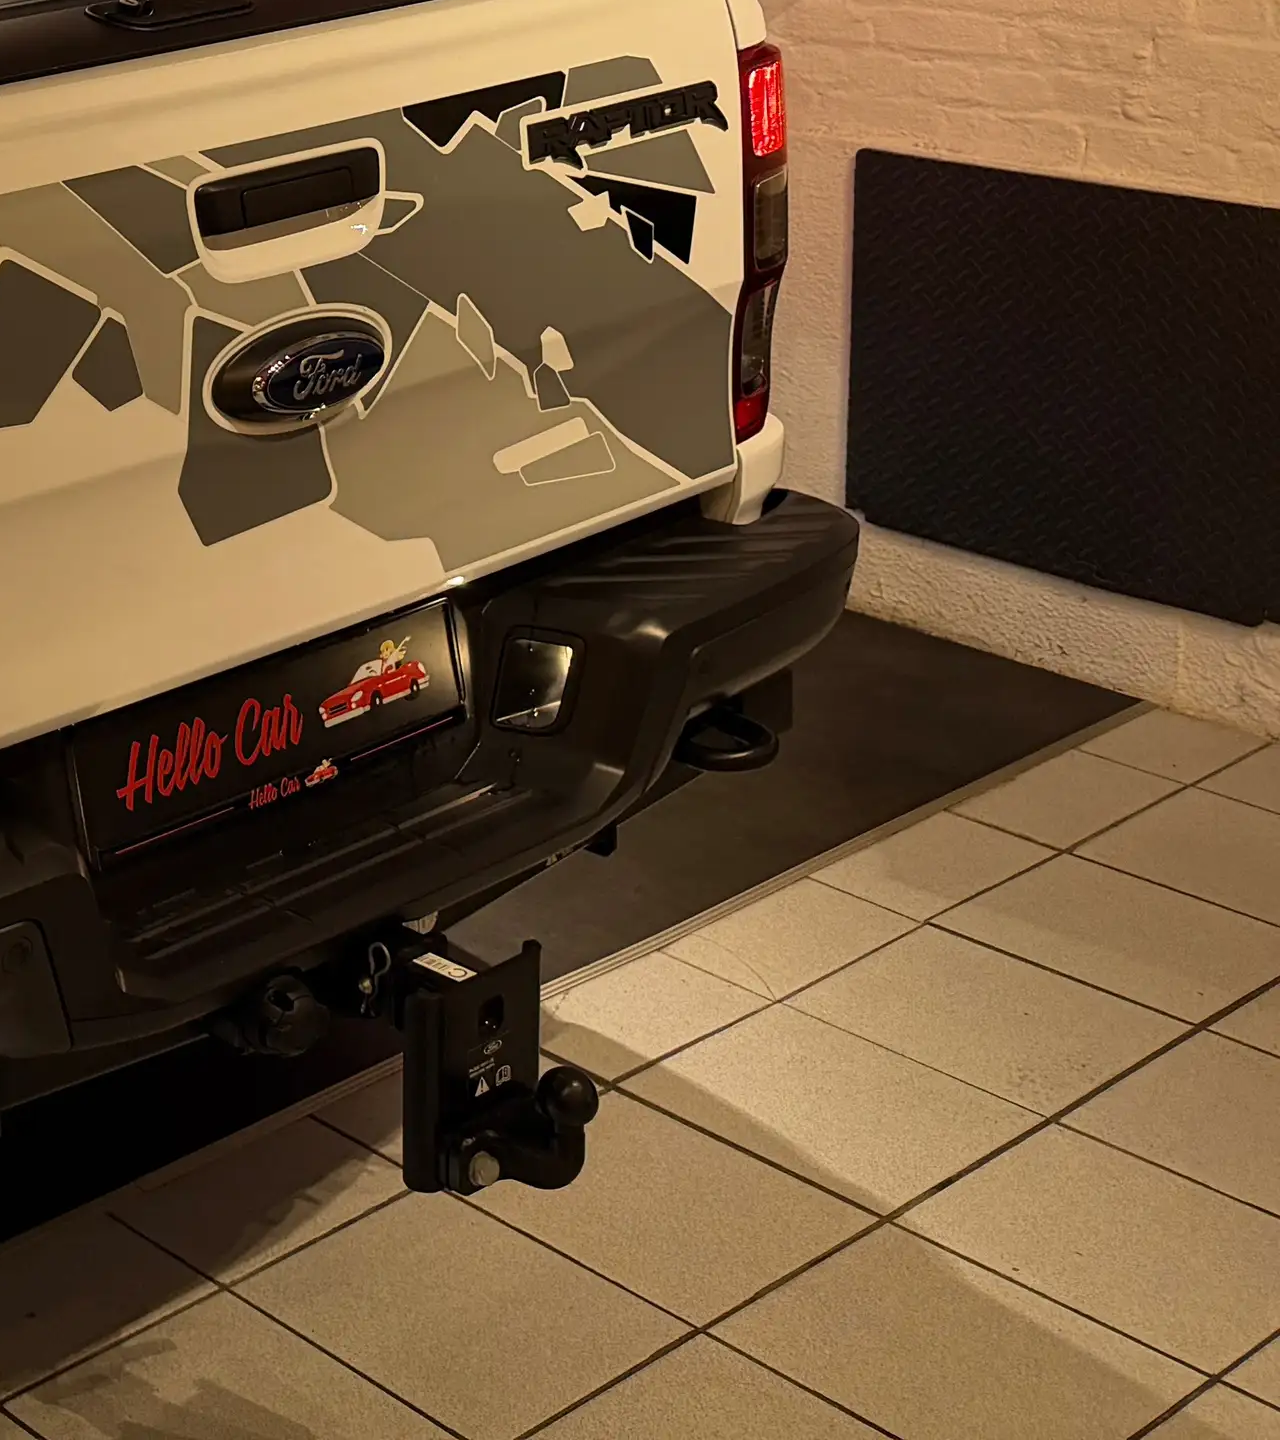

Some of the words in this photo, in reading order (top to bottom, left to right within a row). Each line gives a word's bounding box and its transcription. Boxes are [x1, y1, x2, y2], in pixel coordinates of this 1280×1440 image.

[525, 79, 730, 170] RAPTOR
[293, 347, 365, 404] Ford
[116, 716, 228, 811] Hello
[234, 693, 303, 766] Car
[248, 782, 278, 810] Hello
[280, 776, 301, 798] Car
